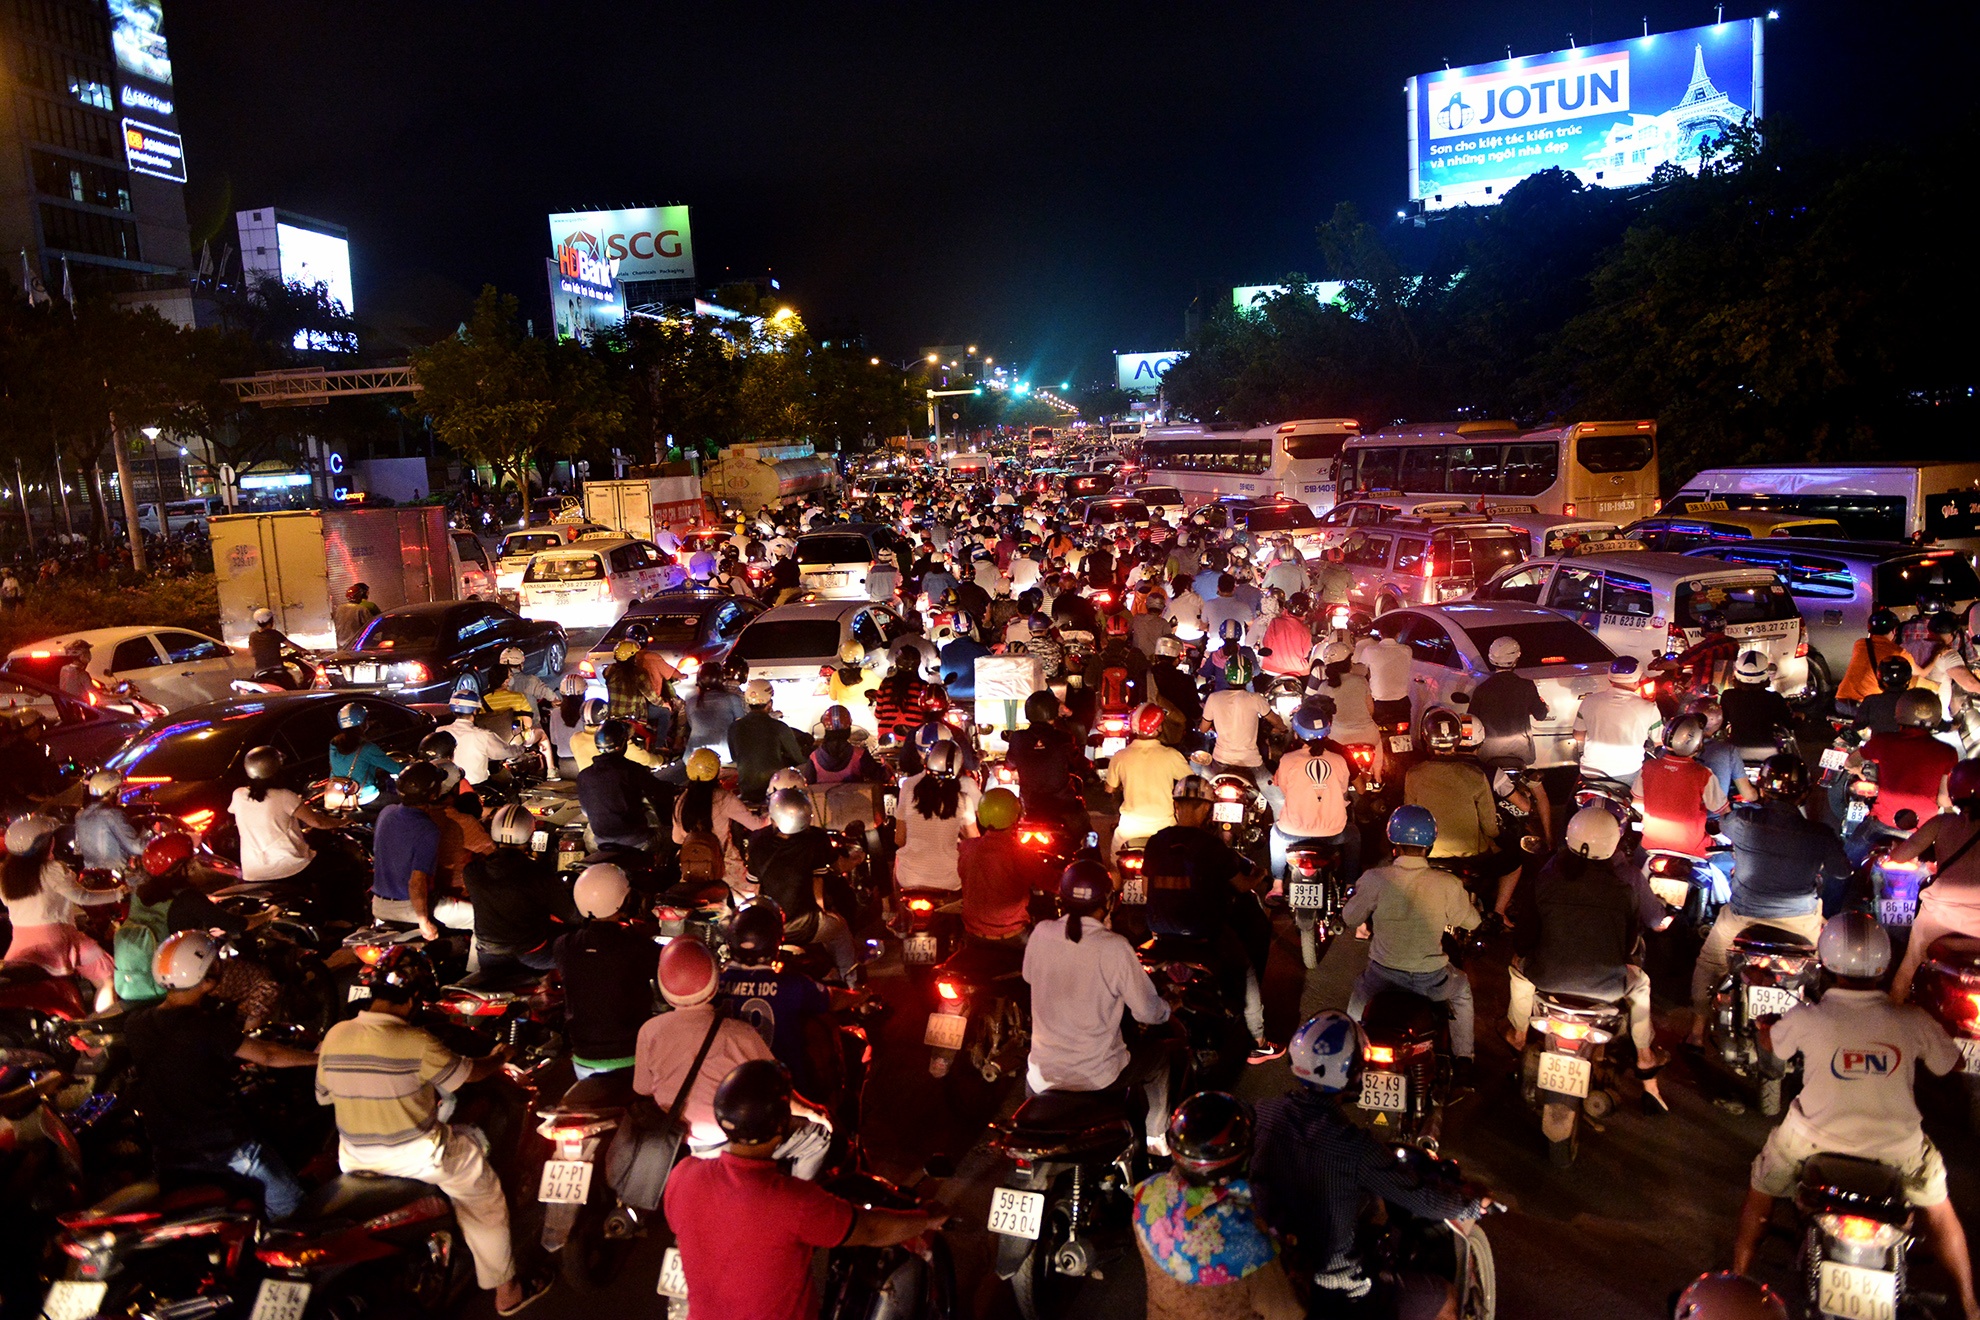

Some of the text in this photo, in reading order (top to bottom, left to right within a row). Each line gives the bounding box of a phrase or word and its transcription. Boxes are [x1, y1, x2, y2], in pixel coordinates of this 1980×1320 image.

[1479, 69, 1619, 125] JOTUN
[1430, 144, 1453, 156] Sơn
[1455, 139, 1477, 152] cho
[1504, 130, 1525, 145] tác
[1556, 123, 1583, 136] trúc
[1430, 155, 1445, 169] và
[1518, 142, 1542, 157] nhà
[607, 230, 682, 260] SCG
[558, 244, 612, 288] HDBank
[1603, 614, 1646, 628] 51A 623 05
[1780, 621, 1788, 630] 27
[1294, 885, 1319, 896] 39-F1
[1294, 895, 1319, 906] 2225
[1547, 1057, 1582, 1077] 36-B4
[1843, 1053, 1888, 1072] PN
[1365, 1074, 1400, 1092] 52-K9
[1541, 1071, 1583, 1094] 363.71
[1364, 1090, 1400, 1108] 6523
[549, 1164, 584, 1182] 47-P1
[545, 1184, 582, 1199] 3475
[1000, 1192, 1034, 1214] 59-E1
[991, 1210, 1035, 1234] 373.04
